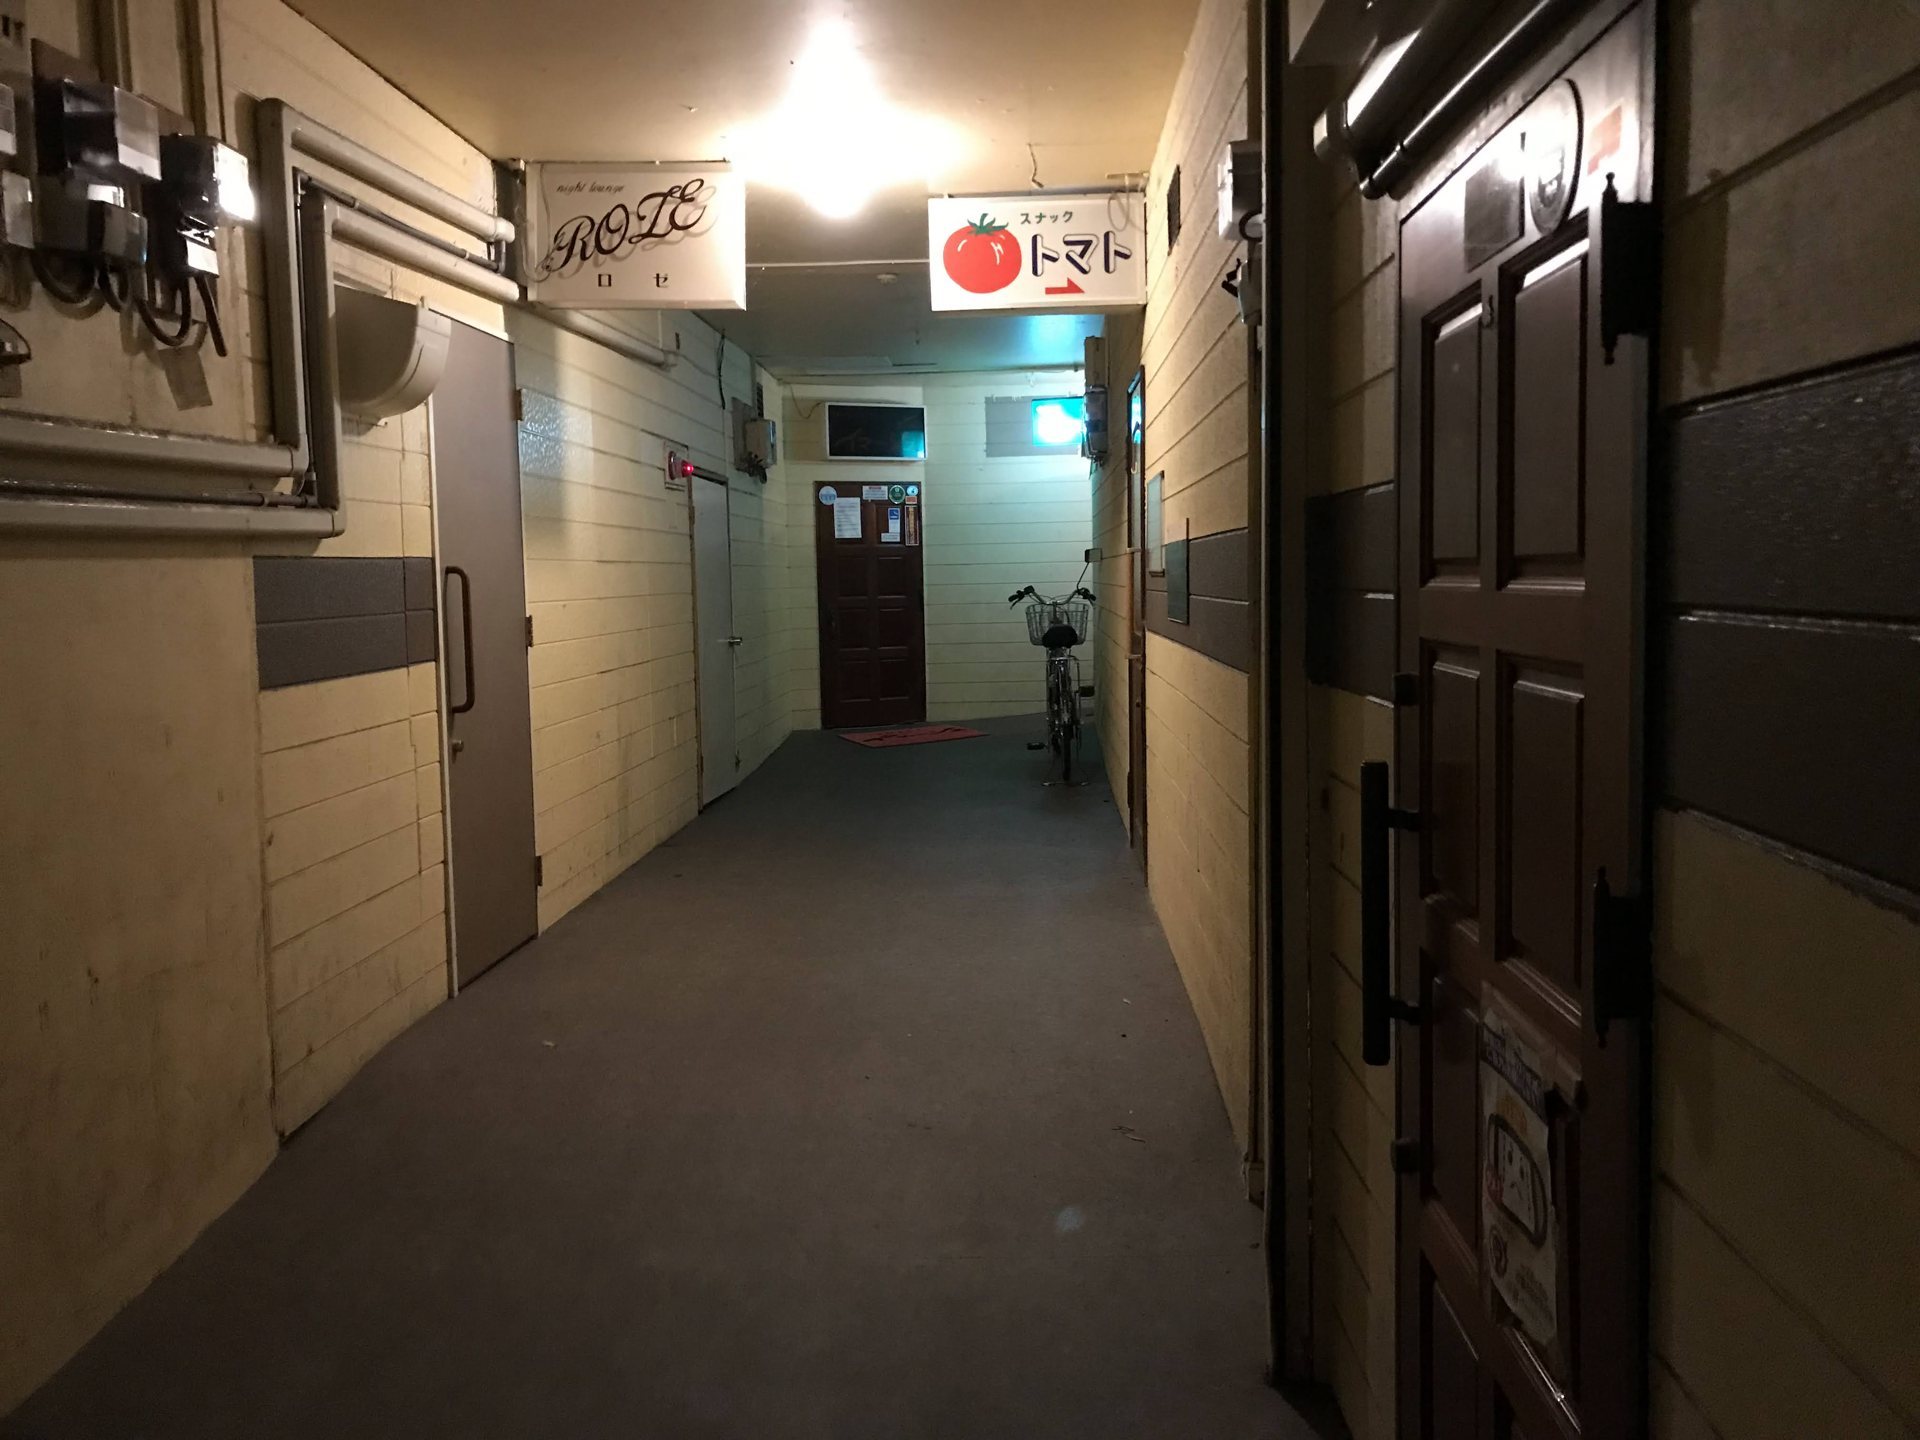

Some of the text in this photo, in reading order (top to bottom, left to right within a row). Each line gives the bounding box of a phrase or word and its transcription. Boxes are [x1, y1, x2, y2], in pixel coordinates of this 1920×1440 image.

[556, 181, 625, 197] night lounge
[1020, 210, 1074, 225] スナック
[1031, 230, 1133, 278] トマト
[597, 273, 670, 288] ロゼ
